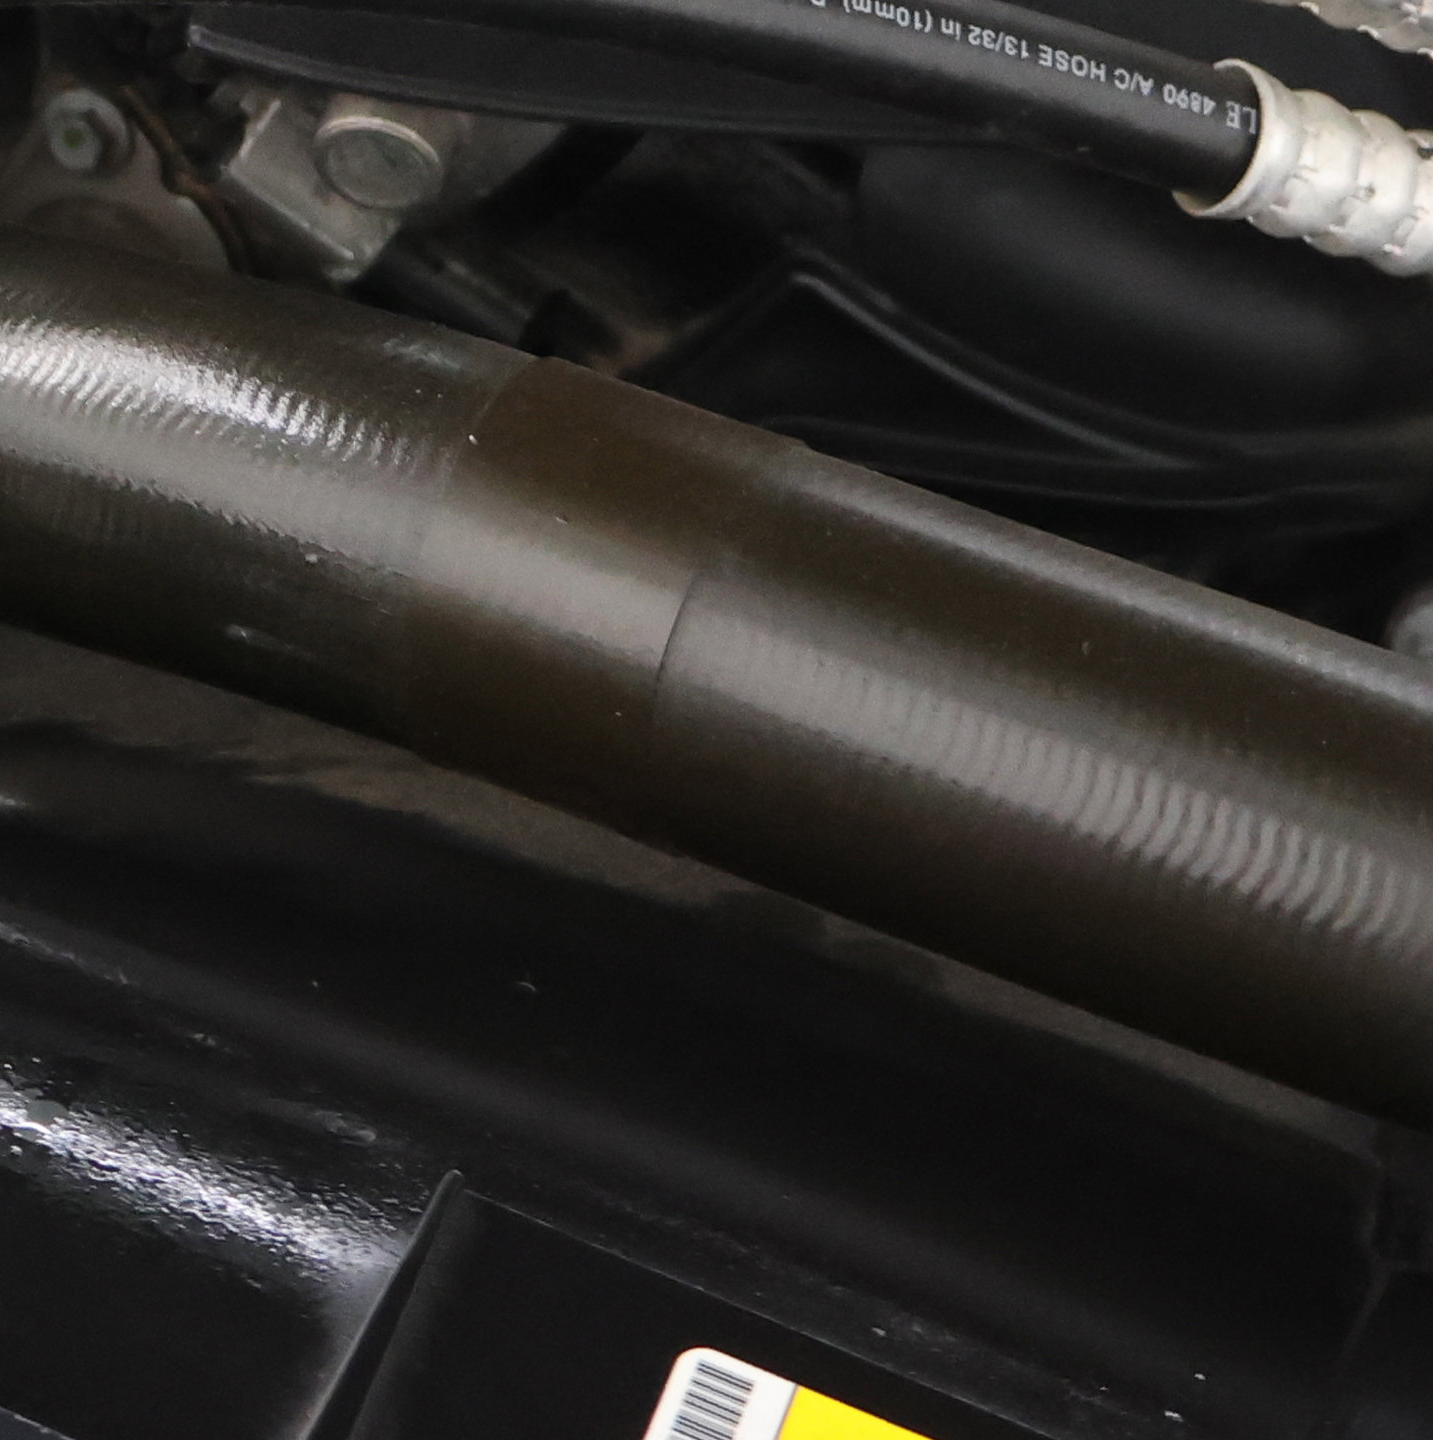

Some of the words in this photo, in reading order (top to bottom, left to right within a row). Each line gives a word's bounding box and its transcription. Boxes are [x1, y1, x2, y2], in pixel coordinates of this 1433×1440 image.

[940, 16, 963, 41] in
[967, 23, 1031, 60] 13/32
[1037, 43, 1108, 84] HOSE
[1113, 67, 1155, 97] A/C
[1162, 83, 1217, 117] 4890
